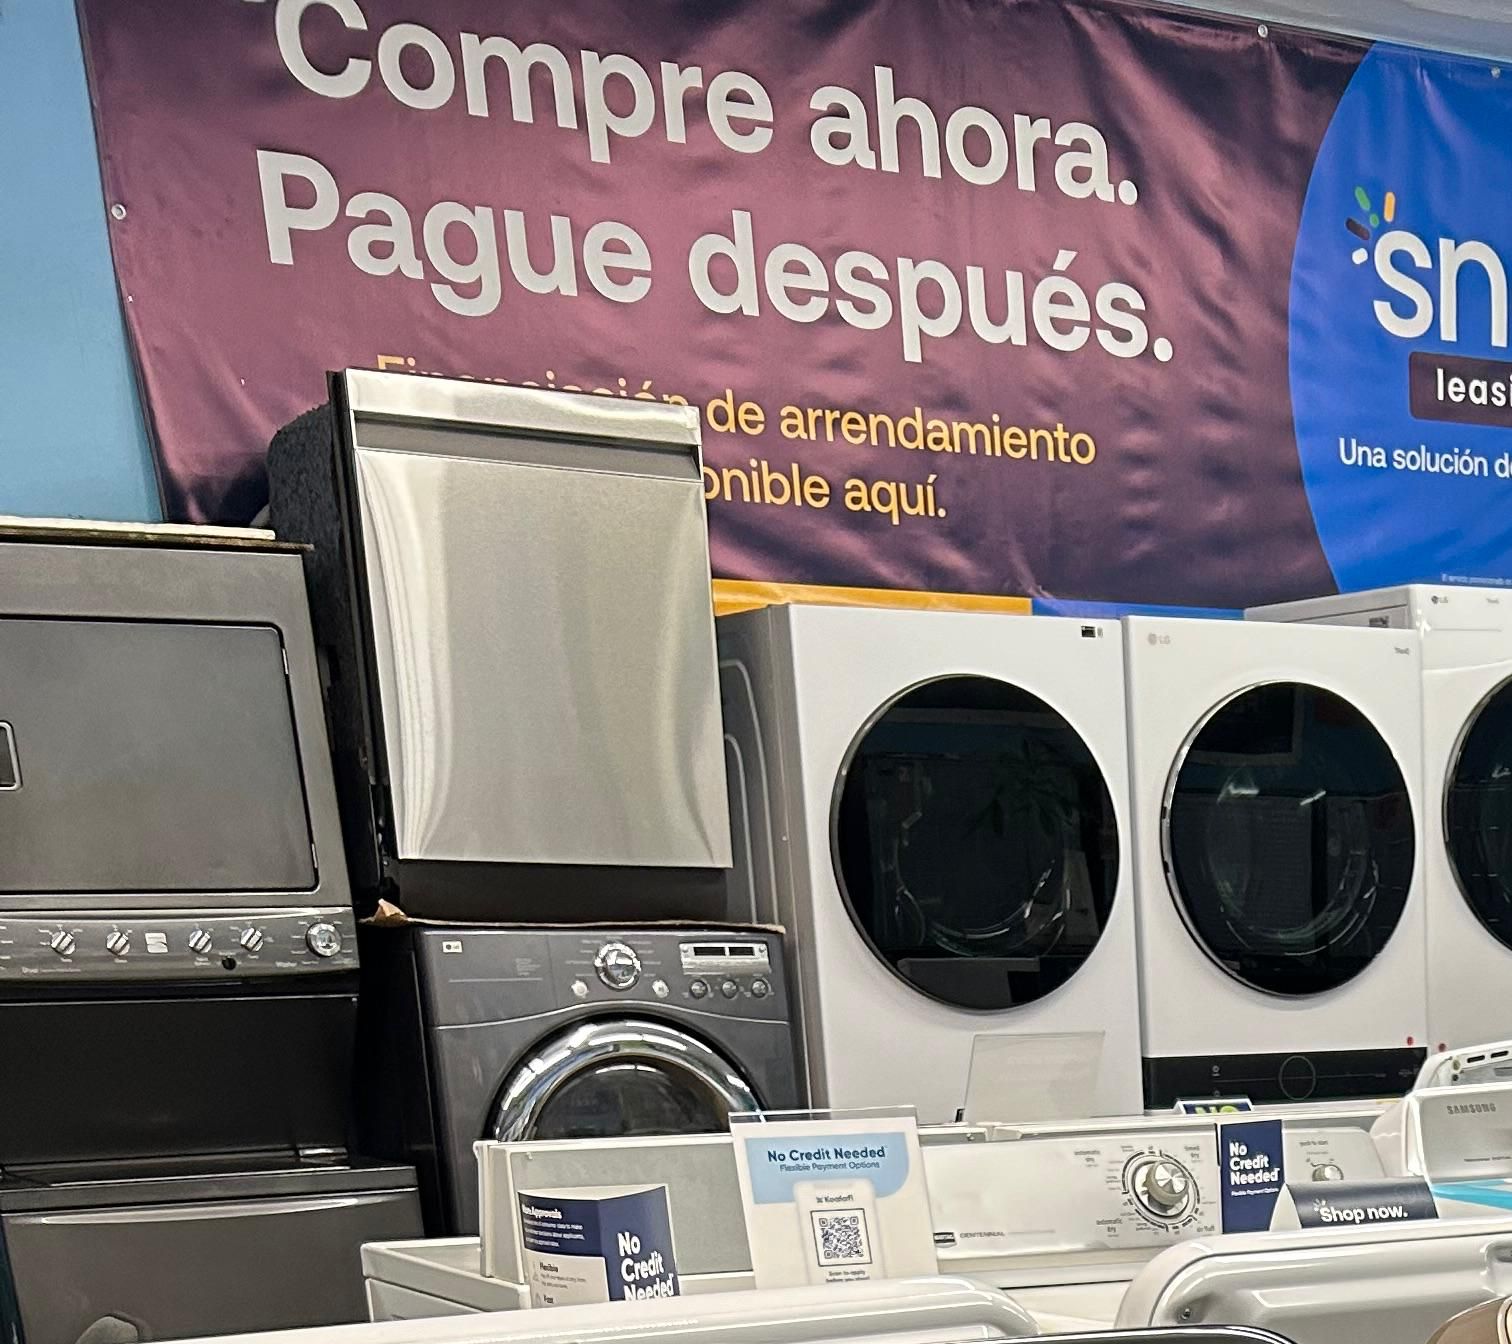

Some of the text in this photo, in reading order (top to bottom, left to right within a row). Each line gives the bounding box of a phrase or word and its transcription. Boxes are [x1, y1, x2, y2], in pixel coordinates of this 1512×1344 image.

[274, 0, 1138, 206] Compre ahora.
[256, 149, 1173, 363] Pague después.
[706, 389, 1095, 464] de arrendamiento
[1339, 438, 1386, 467] Una
[1393, 448, 1488, 477] solución
[704, 459, 946, 525] onible aquí.
[1446, 1103, 1496, 1115] SAMSUNG
[768, 1146, 886, 1162] No Credit Needed
[1229, 1143, 1247, 1157] No
[1230, 1155, 1269, 1170] Credit
[812, 1163, 847, 1172] Payment
[849, 1161, 880, 1170] Options
[1230, 1168, 1280, 1185] Needed
[1320, 1205, 1408, 1223] Shop now.
[617, 1232, 641, 1257] No
[621, 1251, 664, 1281] Credit
[623, 1273, 674, 1301] Needed
